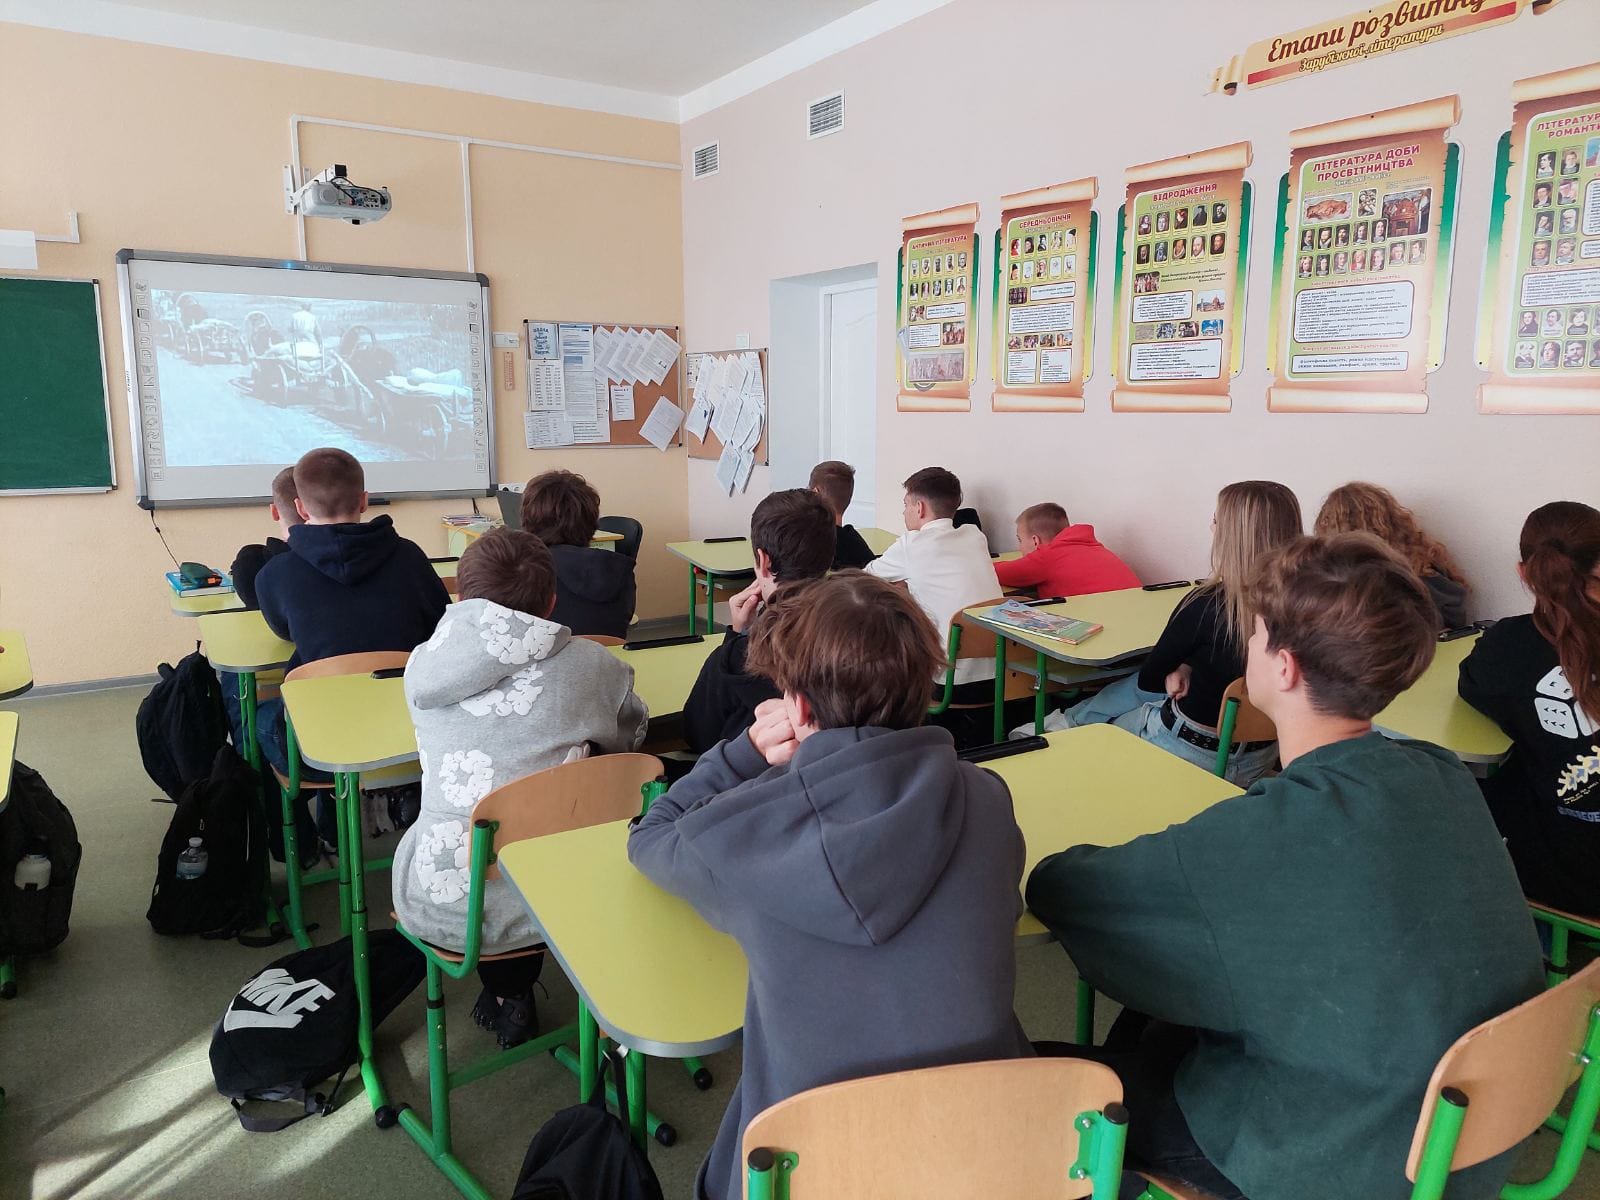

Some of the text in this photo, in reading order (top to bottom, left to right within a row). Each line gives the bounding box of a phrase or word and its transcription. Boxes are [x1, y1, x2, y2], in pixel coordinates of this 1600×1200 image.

[1268, 26, 1346, 62] Етапи
[1299, 24, 1445, 72] Зарубіжної літератури
[1313, 144, 1421, 173] ЛІТЕРАТУРА ДОБИ
[1317, 158, 1414, 182] ПРОСВІТНИЦТВА
[1153, 183, 1218, 202] ВІДРОДЖЕННЯ
[1019, 213, 1072, 229] СЕРЕДНЬОВІЧЧЯ
